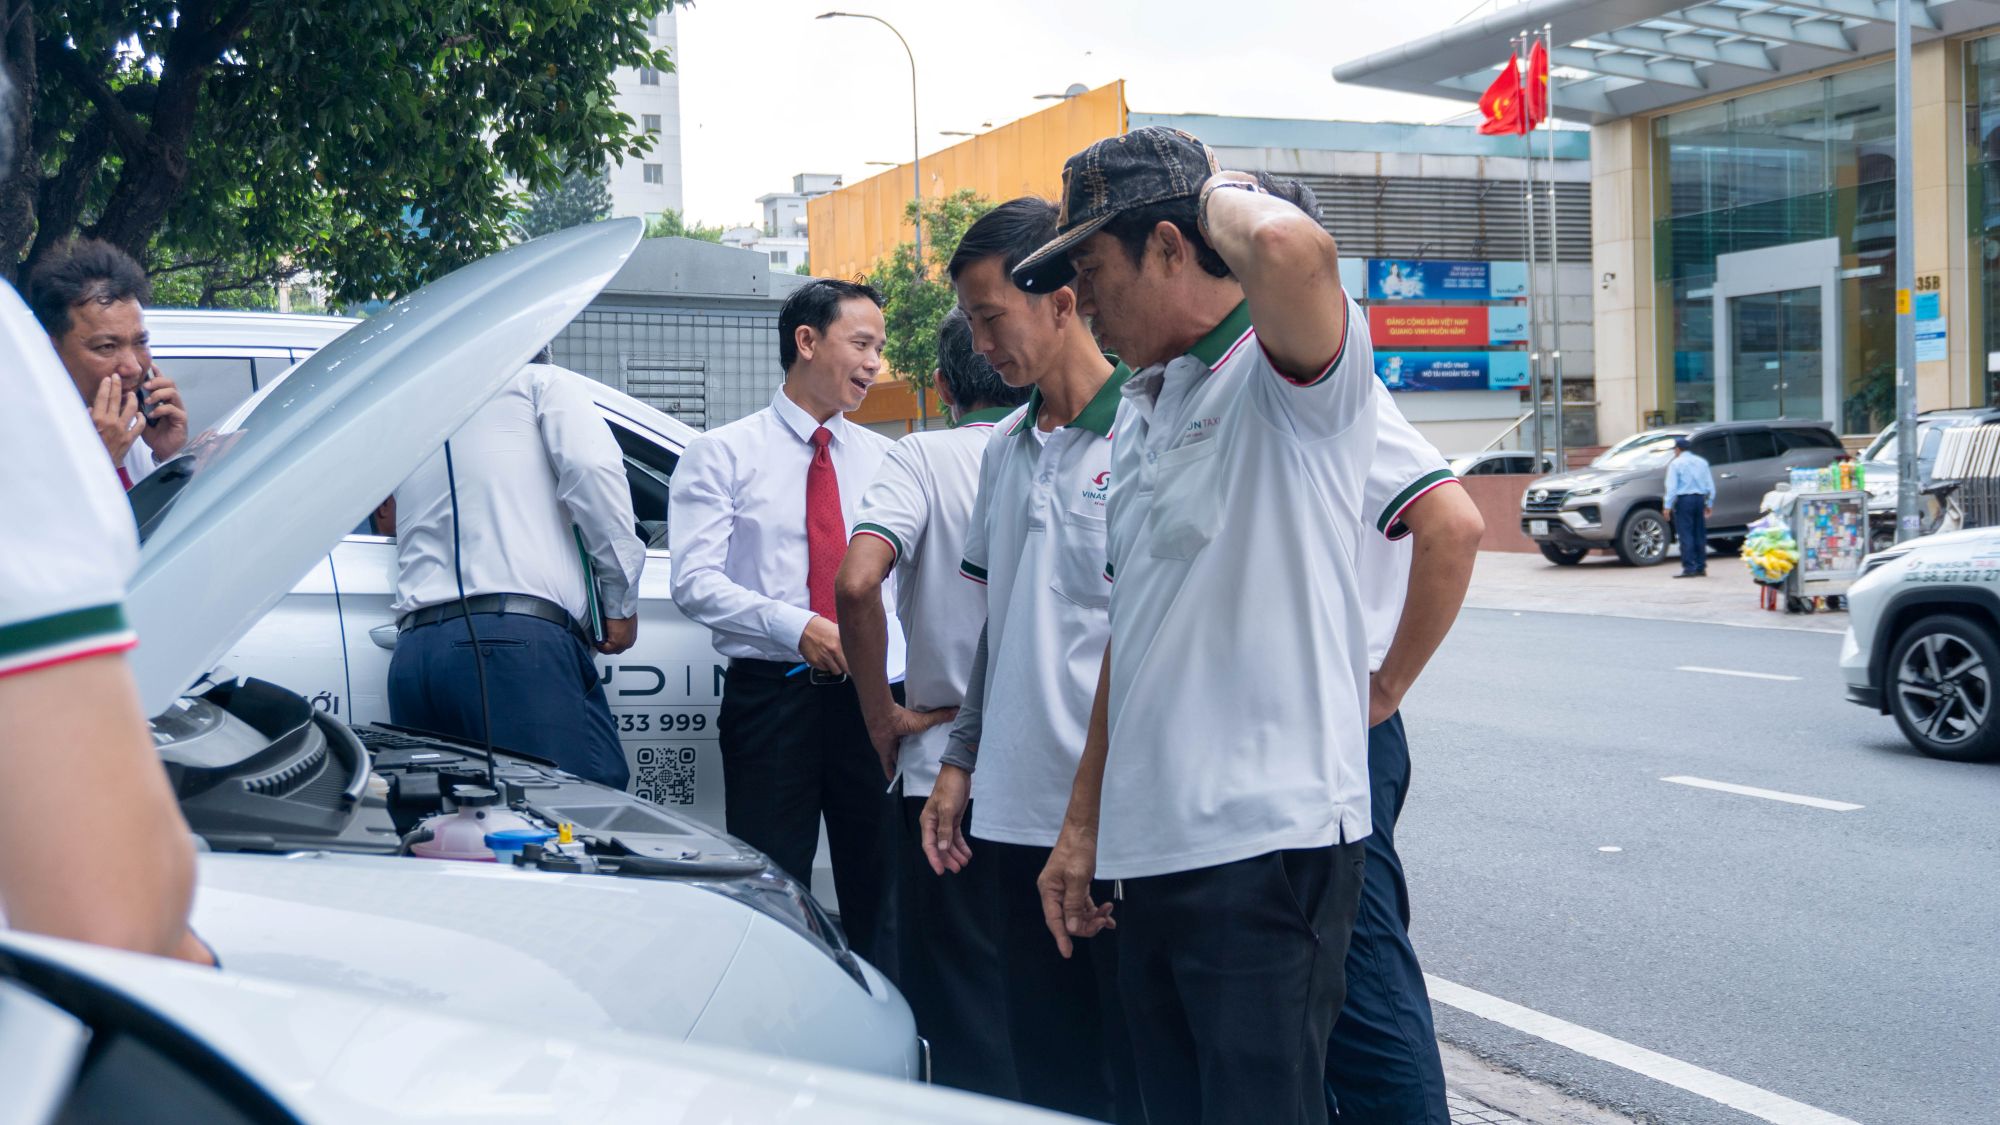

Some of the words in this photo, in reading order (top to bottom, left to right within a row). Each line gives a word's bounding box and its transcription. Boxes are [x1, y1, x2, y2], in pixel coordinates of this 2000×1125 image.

[1917, 275, 1941, 291] 35B
[1202, 416, 1220, 428] TAXI
[660, 713, 706, 732] 999
